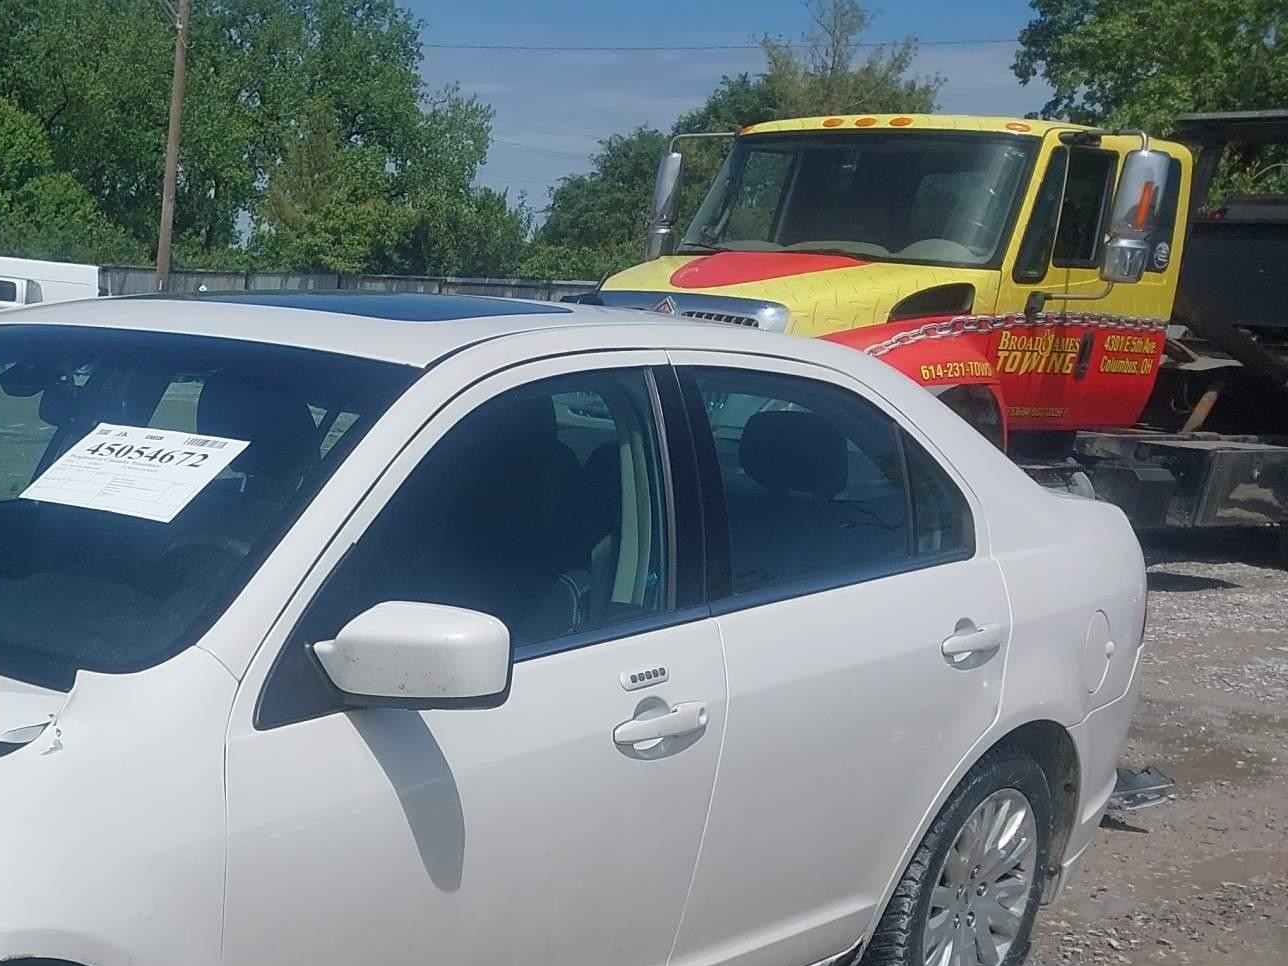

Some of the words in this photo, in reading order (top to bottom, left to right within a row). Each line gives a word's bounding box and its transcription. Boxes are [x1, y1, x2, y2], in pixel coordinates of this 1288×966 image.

[997, 330, 1043, 351] BROAD
[1045, 334, 1081, 356] JAMES
[1104, 335, 1124, 352] 4301
[920, 361, 993, 381] 614-231-TOWS
[996, 350, 1078, 376] TOWING
[1140, 358, 1153, 374] OH
[86, 441, 209, 468] 45054672
